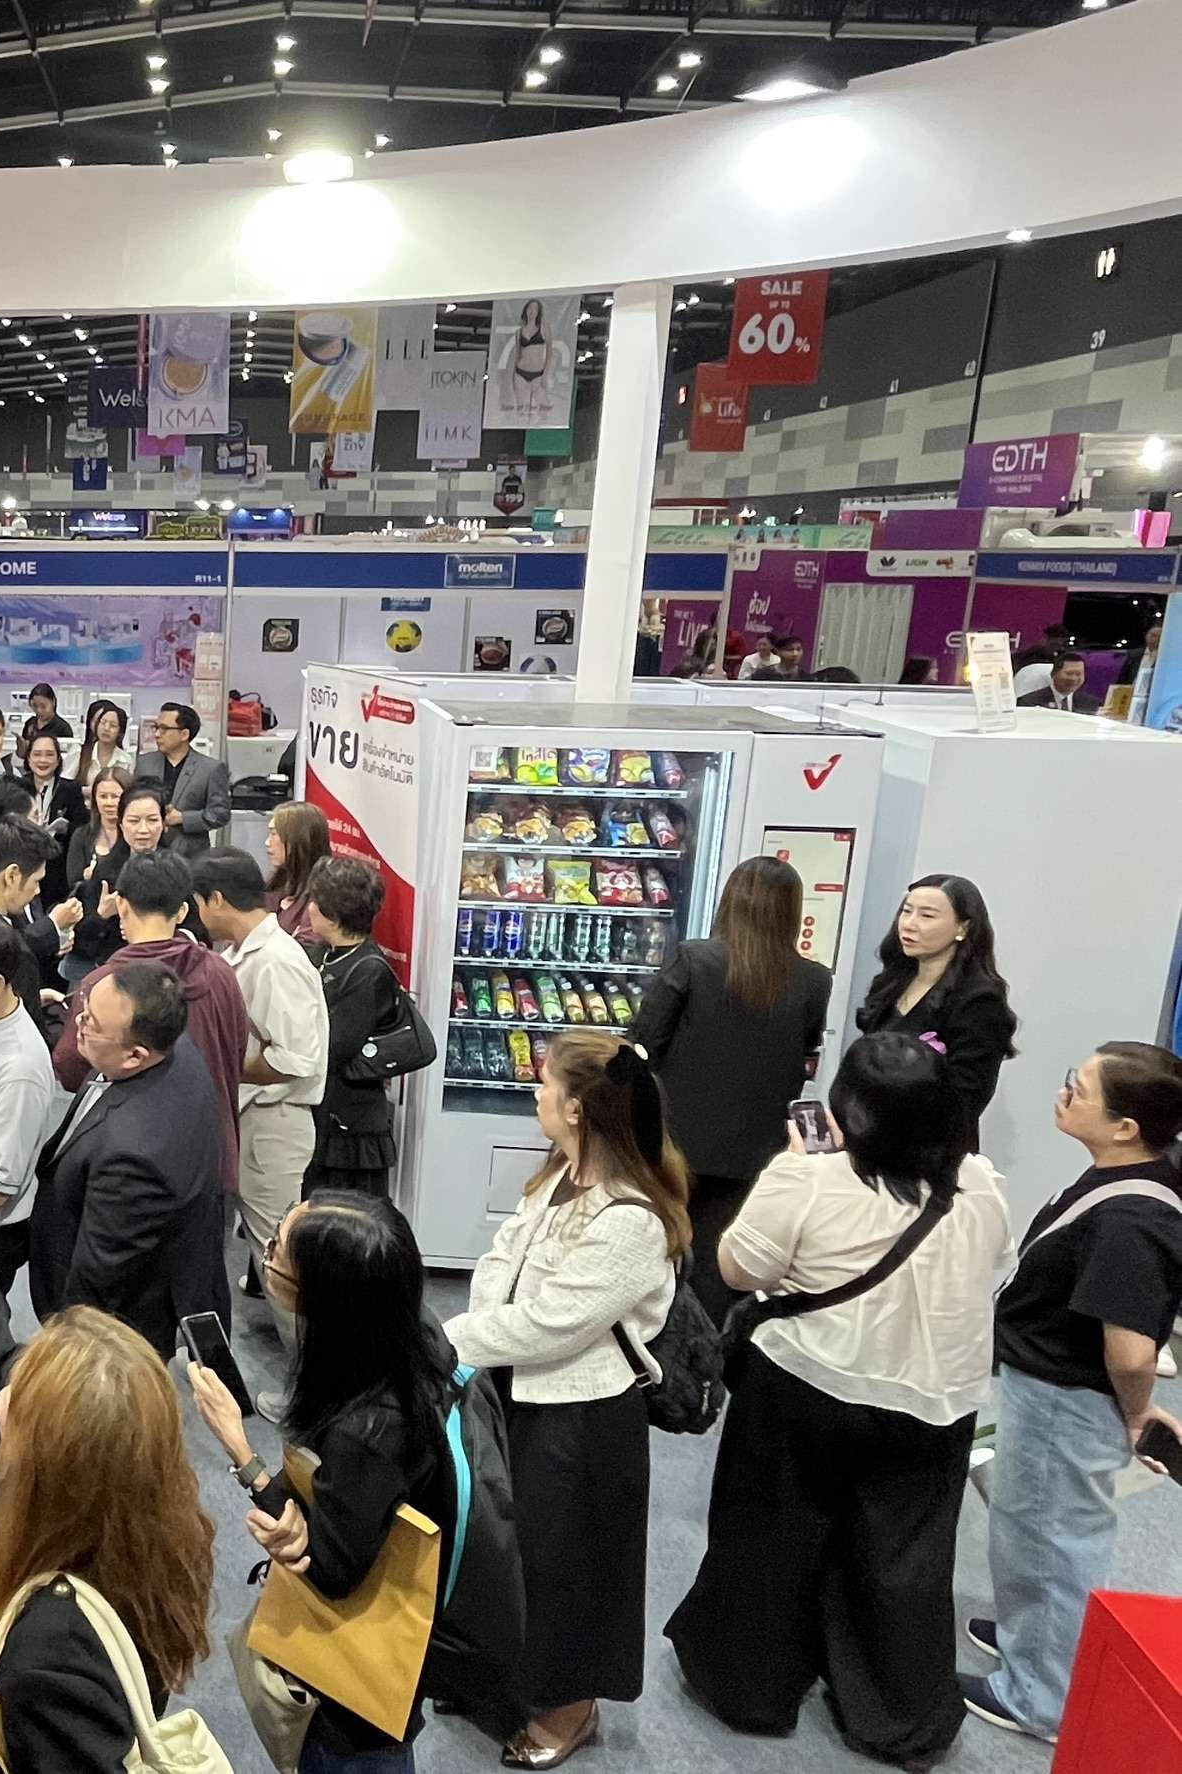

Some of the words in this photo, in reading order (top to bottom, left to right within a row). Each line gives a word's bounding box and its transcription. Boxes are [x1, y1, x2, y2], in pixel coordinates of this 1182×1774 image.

[761, 281, 802, 295] SALE
[769, 301, 779, 309] UP
[739, 313, 810, 354] 60%
[1090, 329, 1106, 349] 39
[431, 369, 477, 388] ITOKIN
[159, 407, 215, 429] KMA
[992, 441, 1048, 472] EDTH
[458, 562, 503, 573] molten
[310, 685, 338, 711] ธุรกิจ
[309, 720, 359, 769] ขาย
